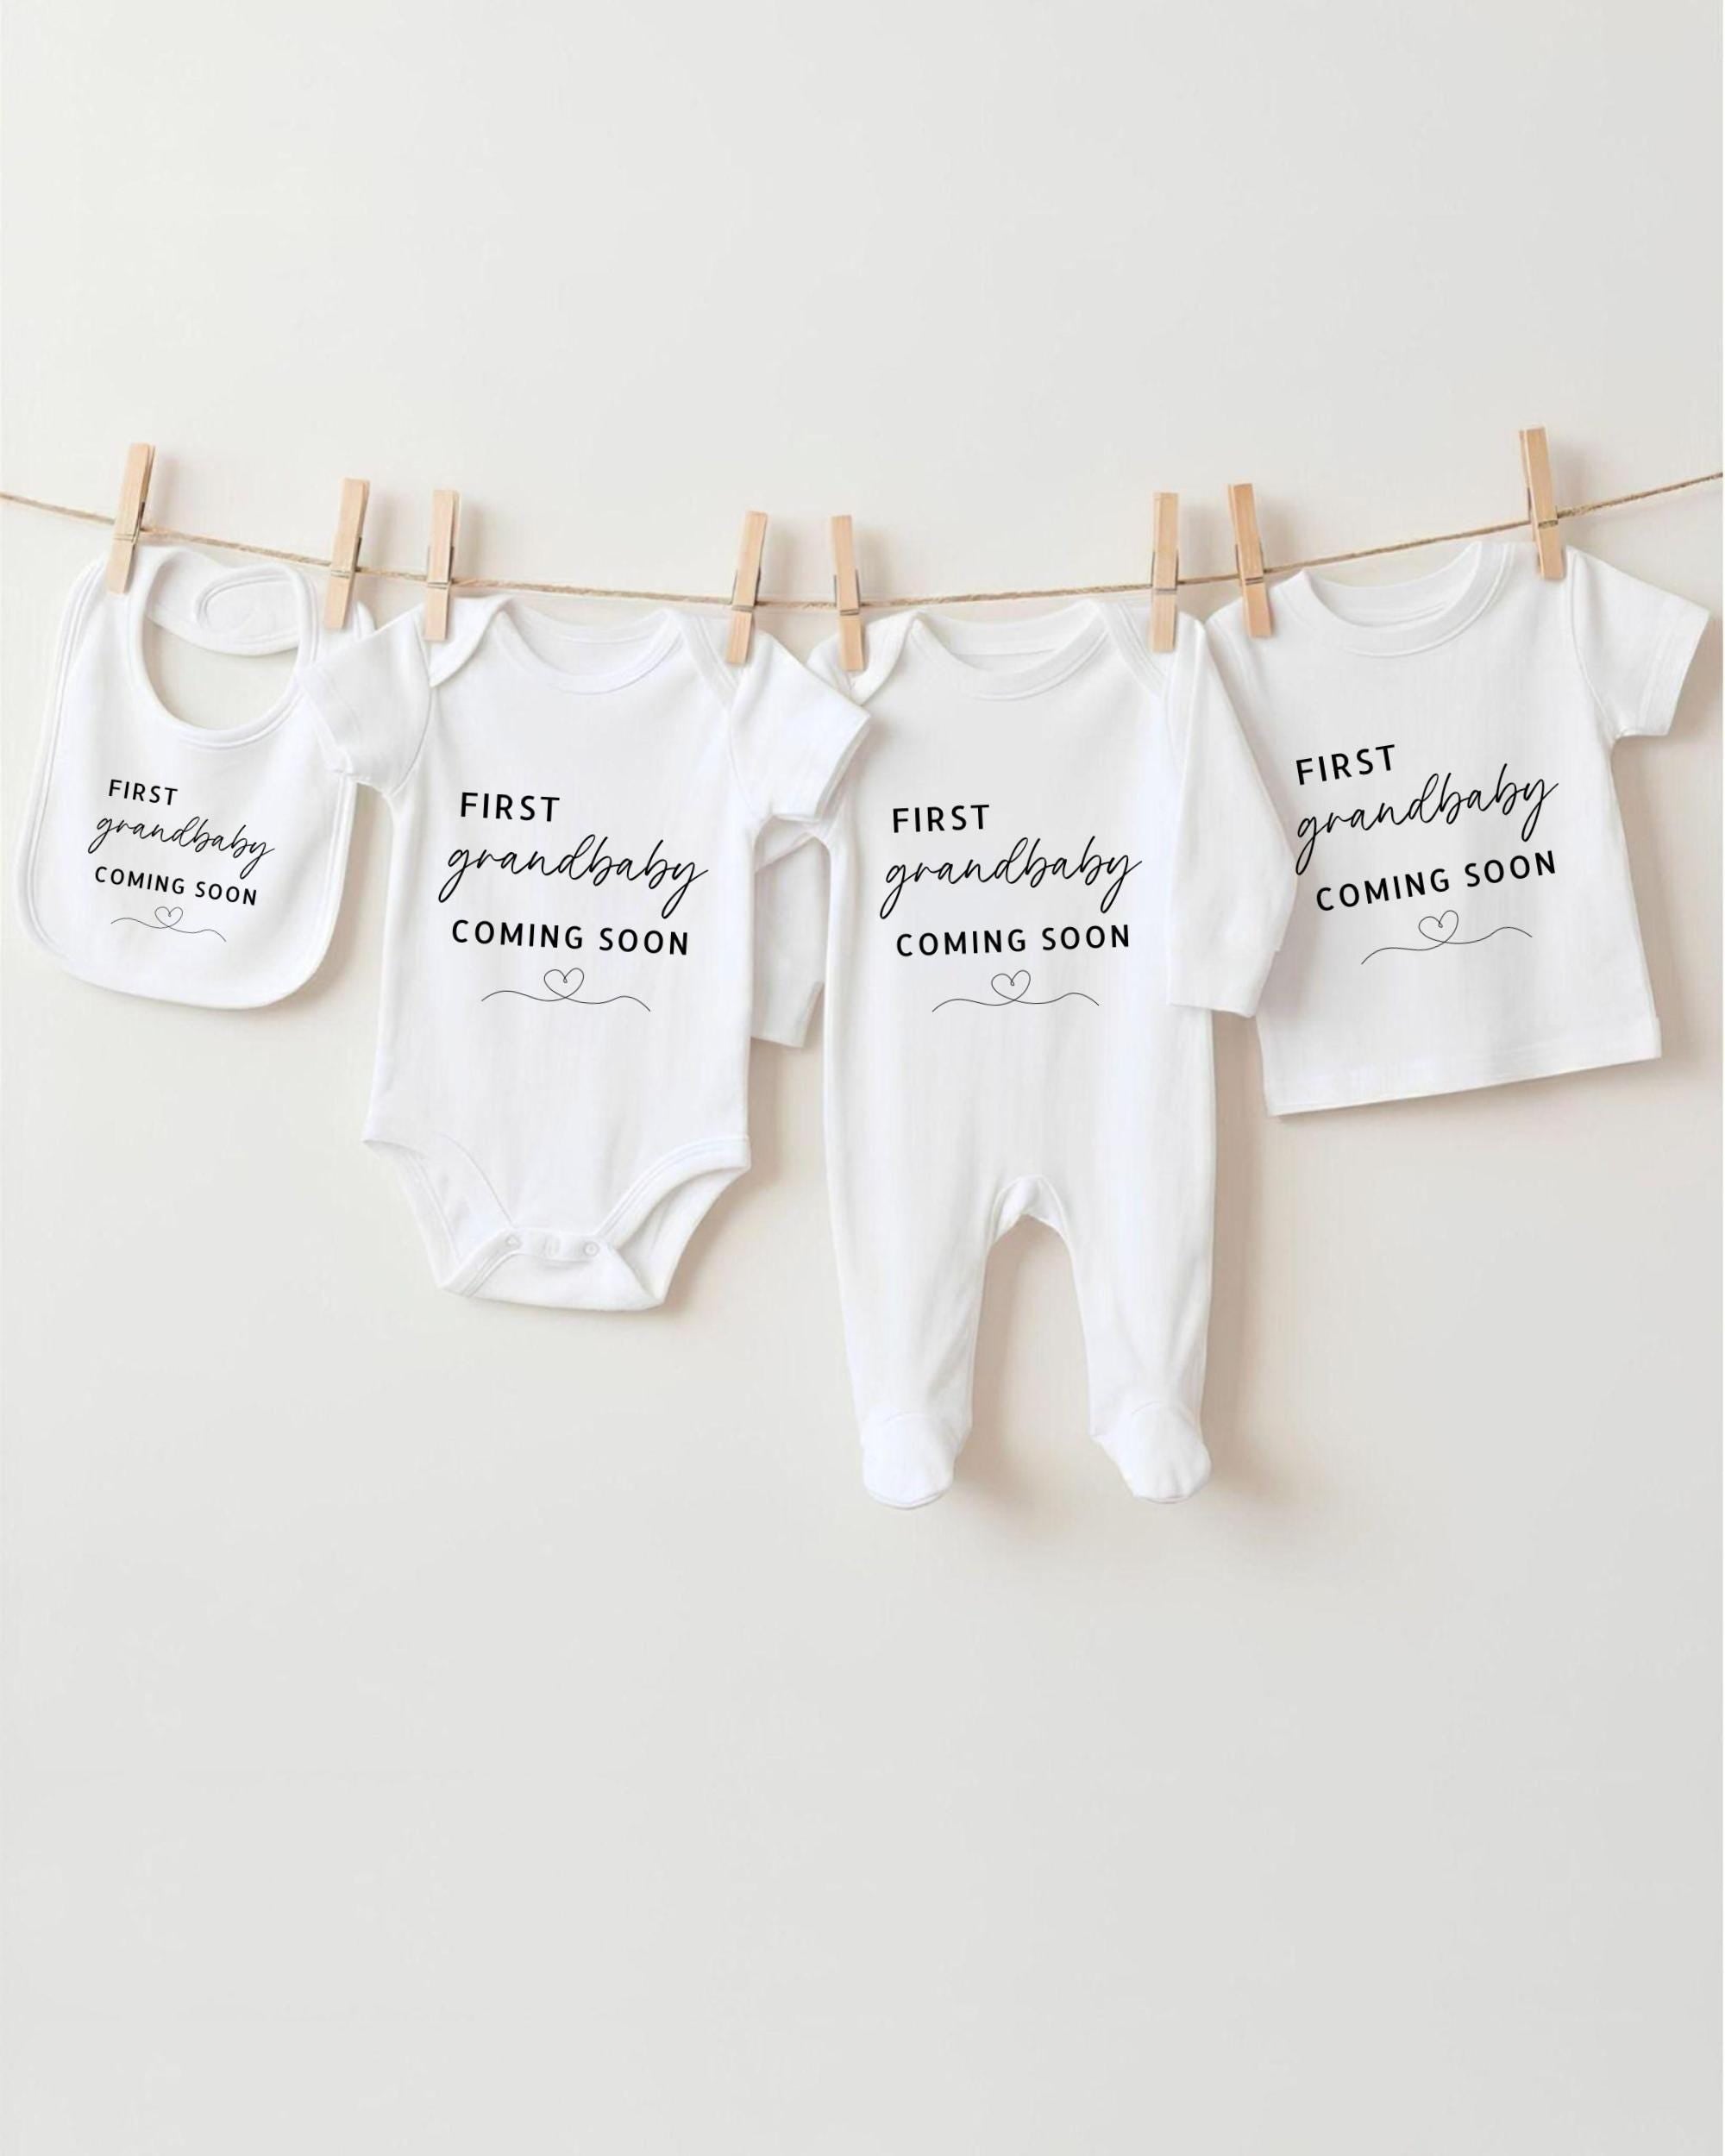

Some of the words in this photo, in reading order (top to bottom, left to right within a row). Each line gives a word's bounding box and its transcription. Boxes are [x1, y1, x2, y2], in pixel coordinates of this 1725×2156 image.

[1295, 743, 1396, 786] FIRST
[108, 779, 179, 805] FIRST
[460, 792, 561, 823] FIRST
[893, 804, 990, 834] FIRST
[1295, 762, 1559, 876] grandbaby
[87, 816, 275, 881] grandbaby
[95, 866, 185, 895] COMING
[194, 881, 257, 906] SOON
[437, 833, 709, 919] grandbaby
[879, 835, 1143, 920] grandbaby
[1315, 868, 1450, 912] COMING
[1464, 849, 1556, 888] SOON
[452, 919, 583, 950] COMING
[599, 927, 688, 956] SOON
[896, 928, 1026, 957] COMING
[1041, 924, 1129, 951] SOON
